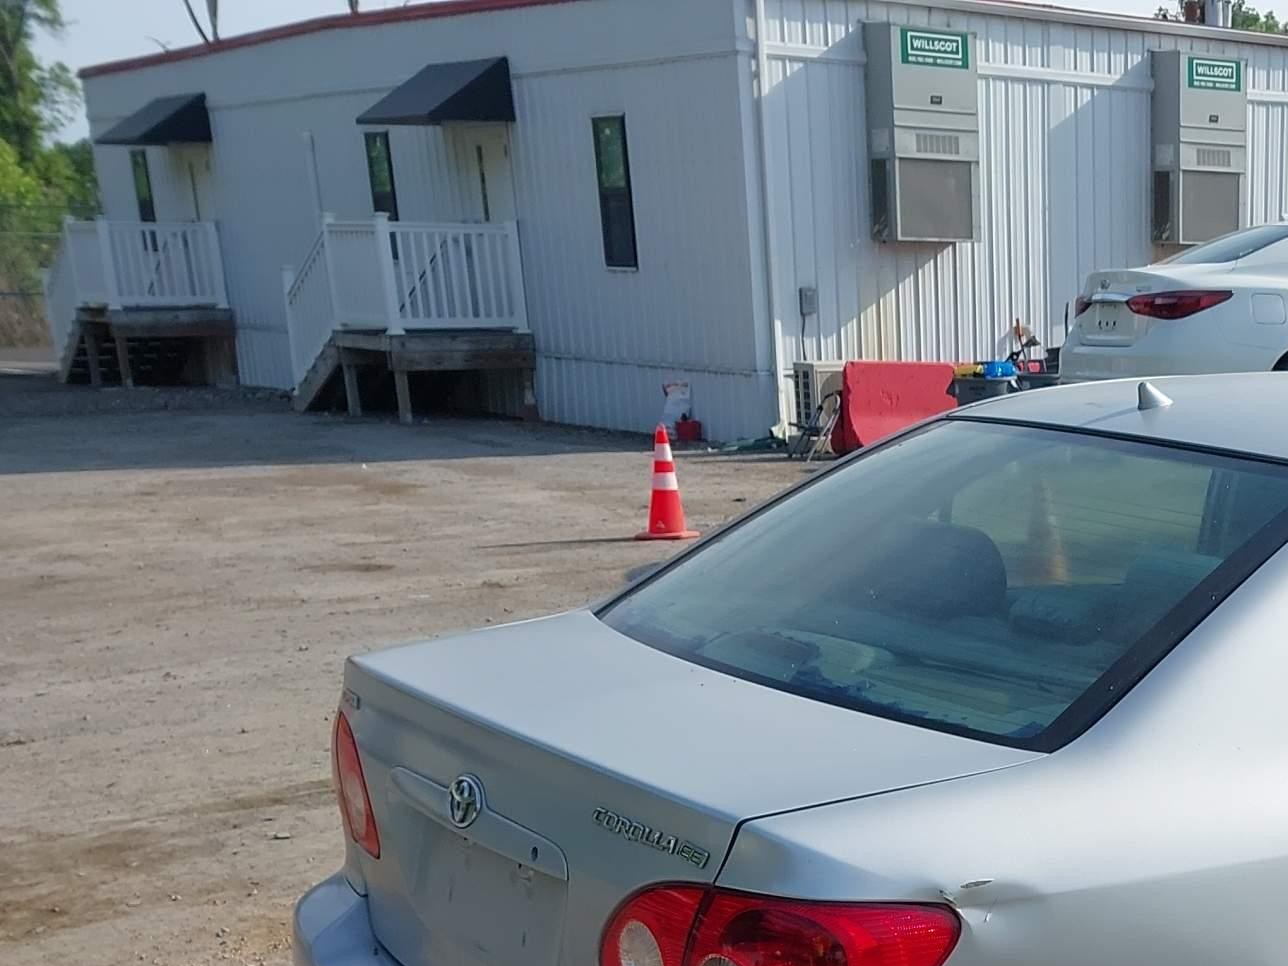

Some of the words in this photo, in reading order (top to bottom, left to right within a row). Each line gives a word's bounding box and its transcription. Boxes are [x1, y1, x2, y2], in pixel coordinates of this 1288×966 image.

[911, 38, 958, 52] WILLSCOT
[1196, 64, 1233, 77] WILLSCOT
[592, 806, 678, 855] COROLLA
